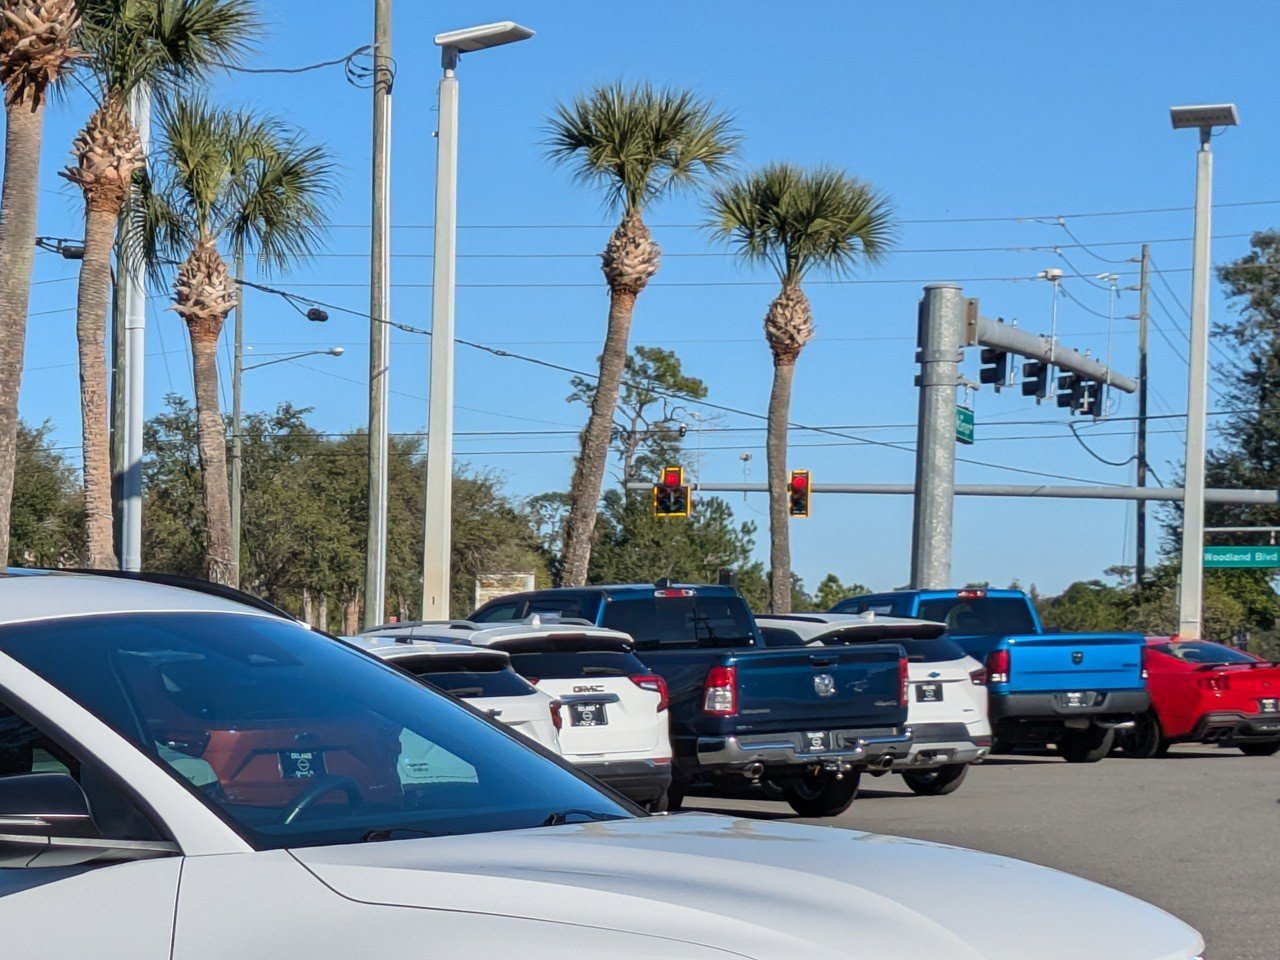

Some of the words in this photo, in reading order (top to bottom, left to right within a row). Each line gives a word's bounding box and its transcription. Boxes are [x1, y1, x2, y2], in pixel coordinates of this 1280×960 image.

[1204, 551, 1251, 561] Woodland
[1255, 552, 1278, 561] Blvd
[573, 685, 604, 693] GMC
